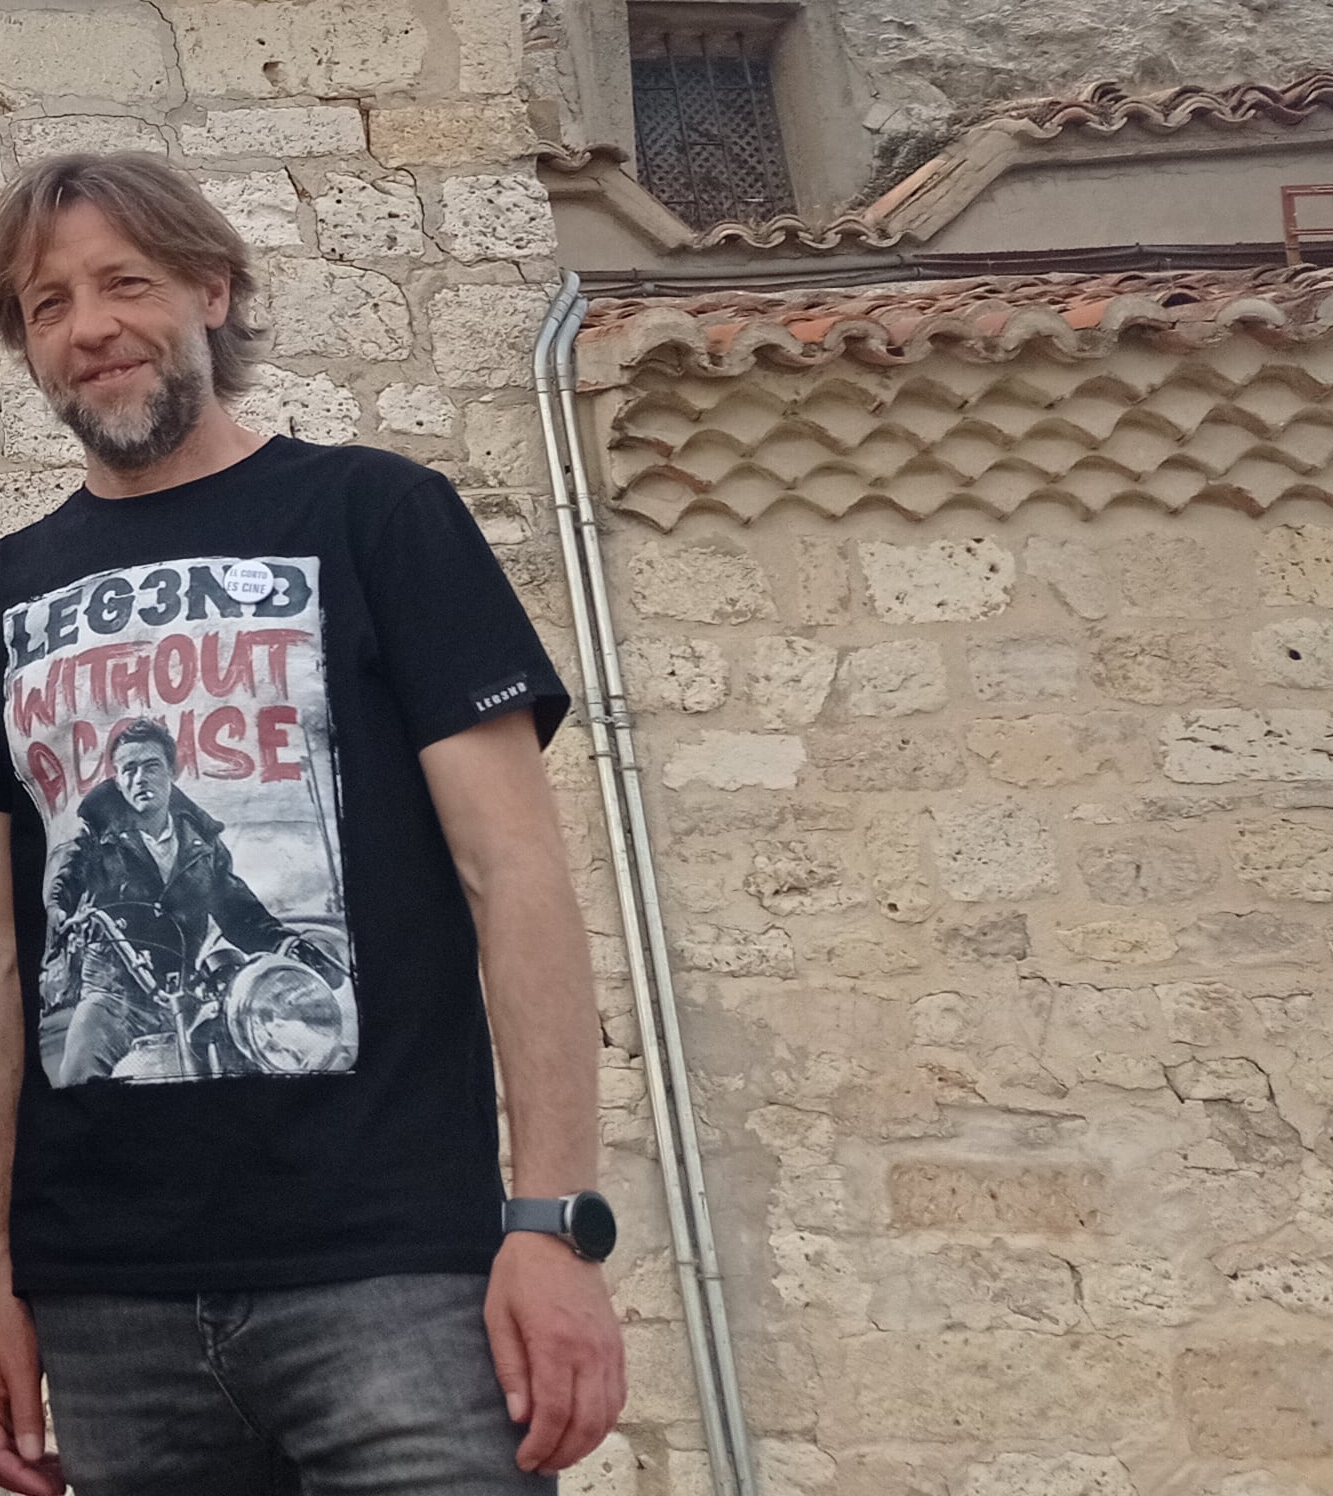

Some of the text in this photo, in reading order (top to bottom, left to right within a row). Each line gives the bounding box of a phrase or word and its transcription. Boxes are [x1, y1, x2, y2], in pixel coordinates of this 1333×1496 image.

[9, 565, 313, 667] LEG3ND
[227, 581, 267, 594] ES CINE
[13, 628, 313, 738] WITHOUT
[27, 741, 68, 819] A
